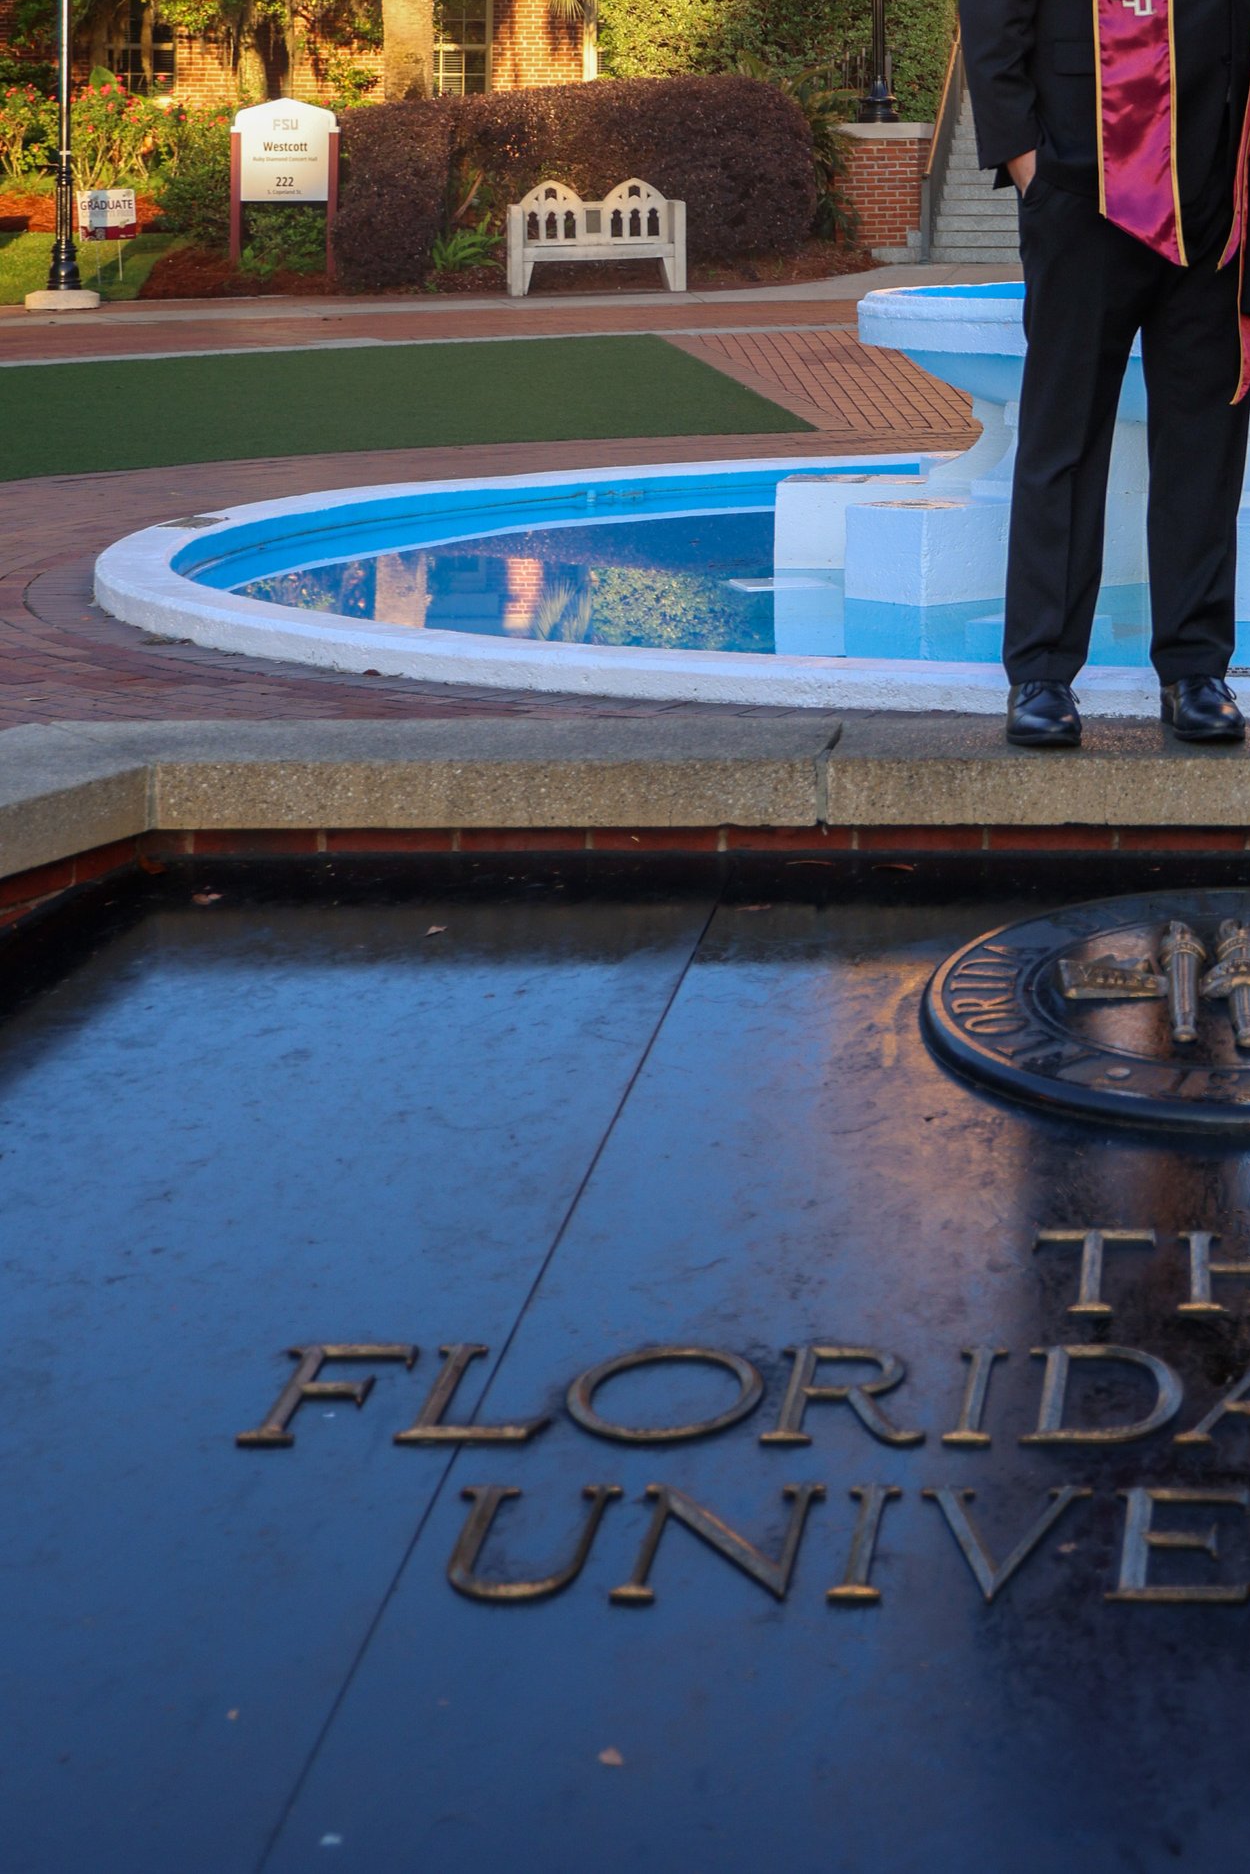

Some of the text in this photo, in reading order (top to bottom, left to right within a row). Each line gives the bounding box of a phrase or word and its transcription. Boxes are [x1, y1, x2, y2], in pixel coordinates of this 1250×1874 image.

[273, 119, 298, 130] FSU
[263, 142, 308, 152] Westcott
[276, 176, 294, 187] 222
[80, 199, 133, 211] GRADUATE
